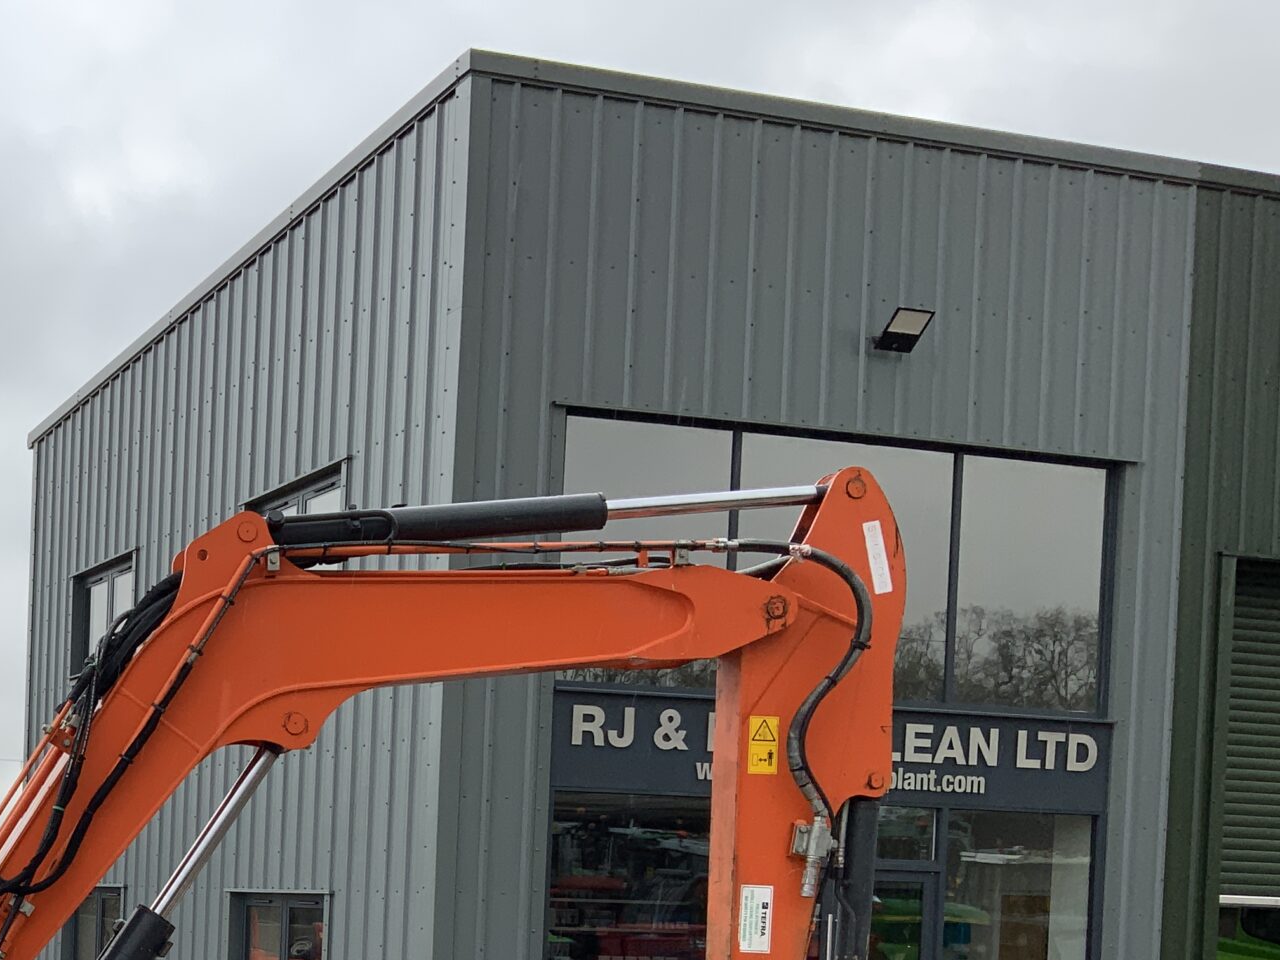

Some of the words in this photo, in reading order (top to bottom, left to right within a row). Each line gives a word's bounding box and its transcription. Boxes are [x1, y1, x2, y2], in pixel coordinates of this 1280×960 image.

[571, 704, 636, 748] RJ
[653, 708, 689, 751] &
[1016, 729, 1098, 772] LTD
